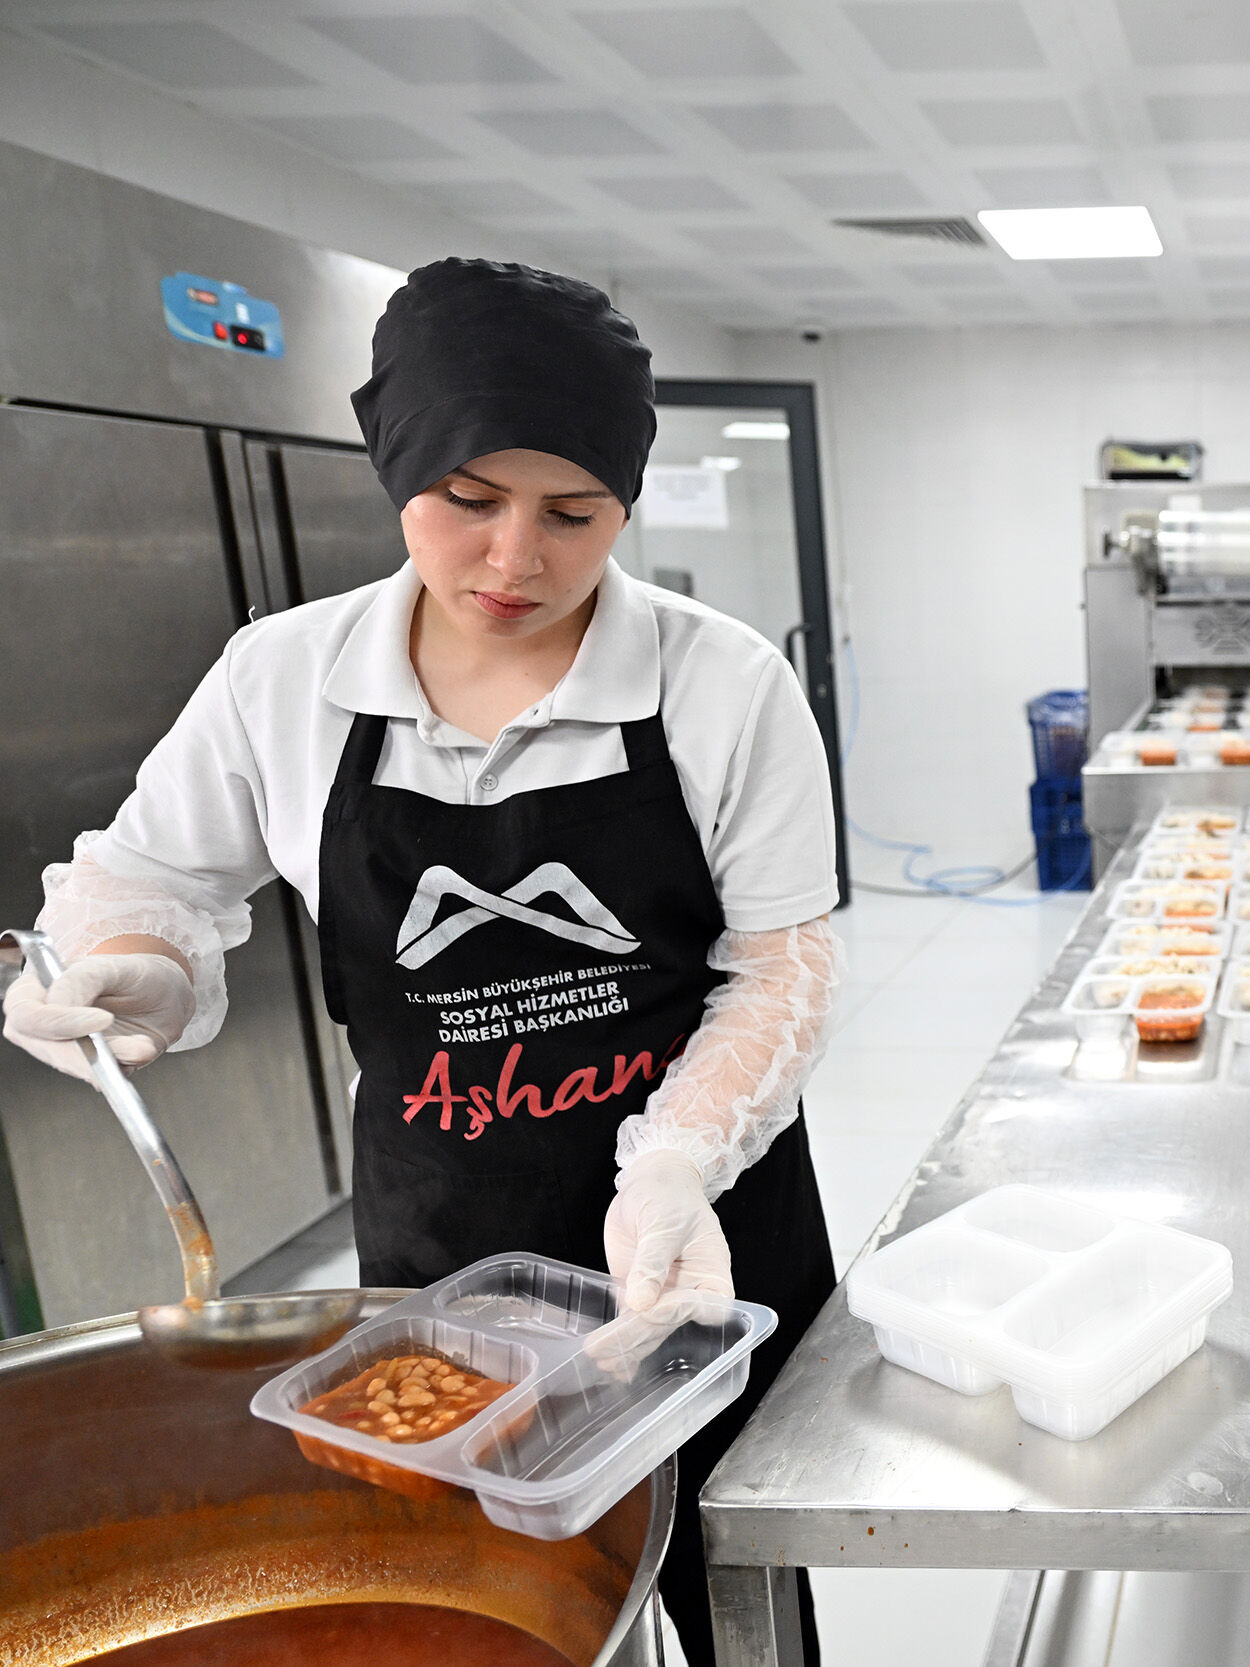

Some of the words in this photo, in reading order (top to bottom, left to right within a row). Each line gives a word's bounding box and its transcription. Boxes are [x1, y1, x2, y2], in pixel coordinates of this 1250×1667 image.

[404, 991, 425, 1004] T.C.
[426, 987, 480, 1005] MERSİN
[482, 970, 574, 999] BÜYÜKŞEHİR
[439, 1002, 514, 1026] SOSYAL
[516, 980, 620, 1015] HİZMETLER
[438, 1018, 509, 1043] DAİRESİ
[513, 995, 630, 1034] BAŞKANLIĞI
